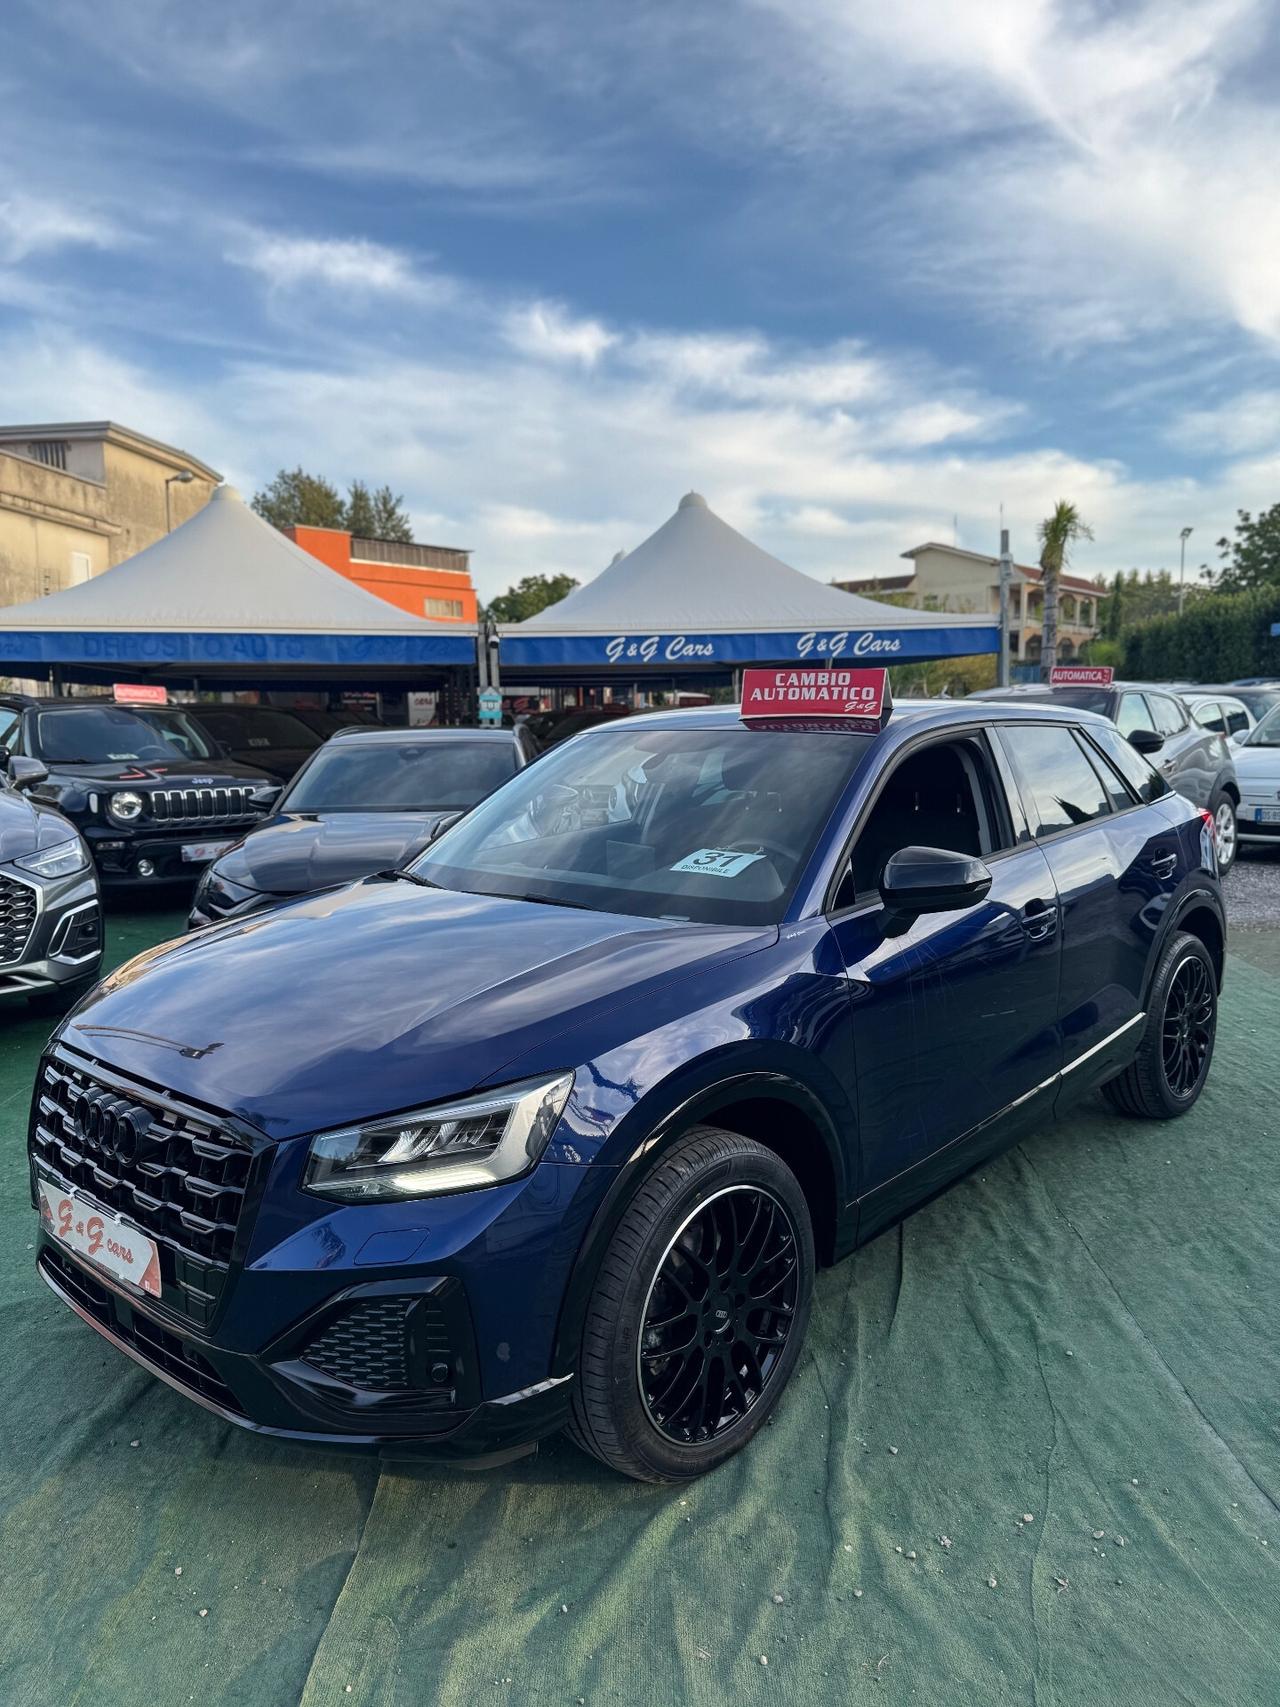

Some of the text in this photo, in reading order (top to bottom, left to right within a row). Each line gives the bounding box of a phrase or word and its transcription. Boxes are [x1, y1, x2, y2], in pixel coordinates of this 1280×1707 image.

[605, 636, 714, 663] G&G Cars
[796, 632, 901, 658] G&G Cars
[775, 672, 851, 687] CAMBIO
[1052, 670, 1102, 681] AUTOMATICA
[749, 686, 875, 701] AUTOMATICO
[692, 851, 743, 868] 31
[680, 864, 731, 874] DISPONIBILE
